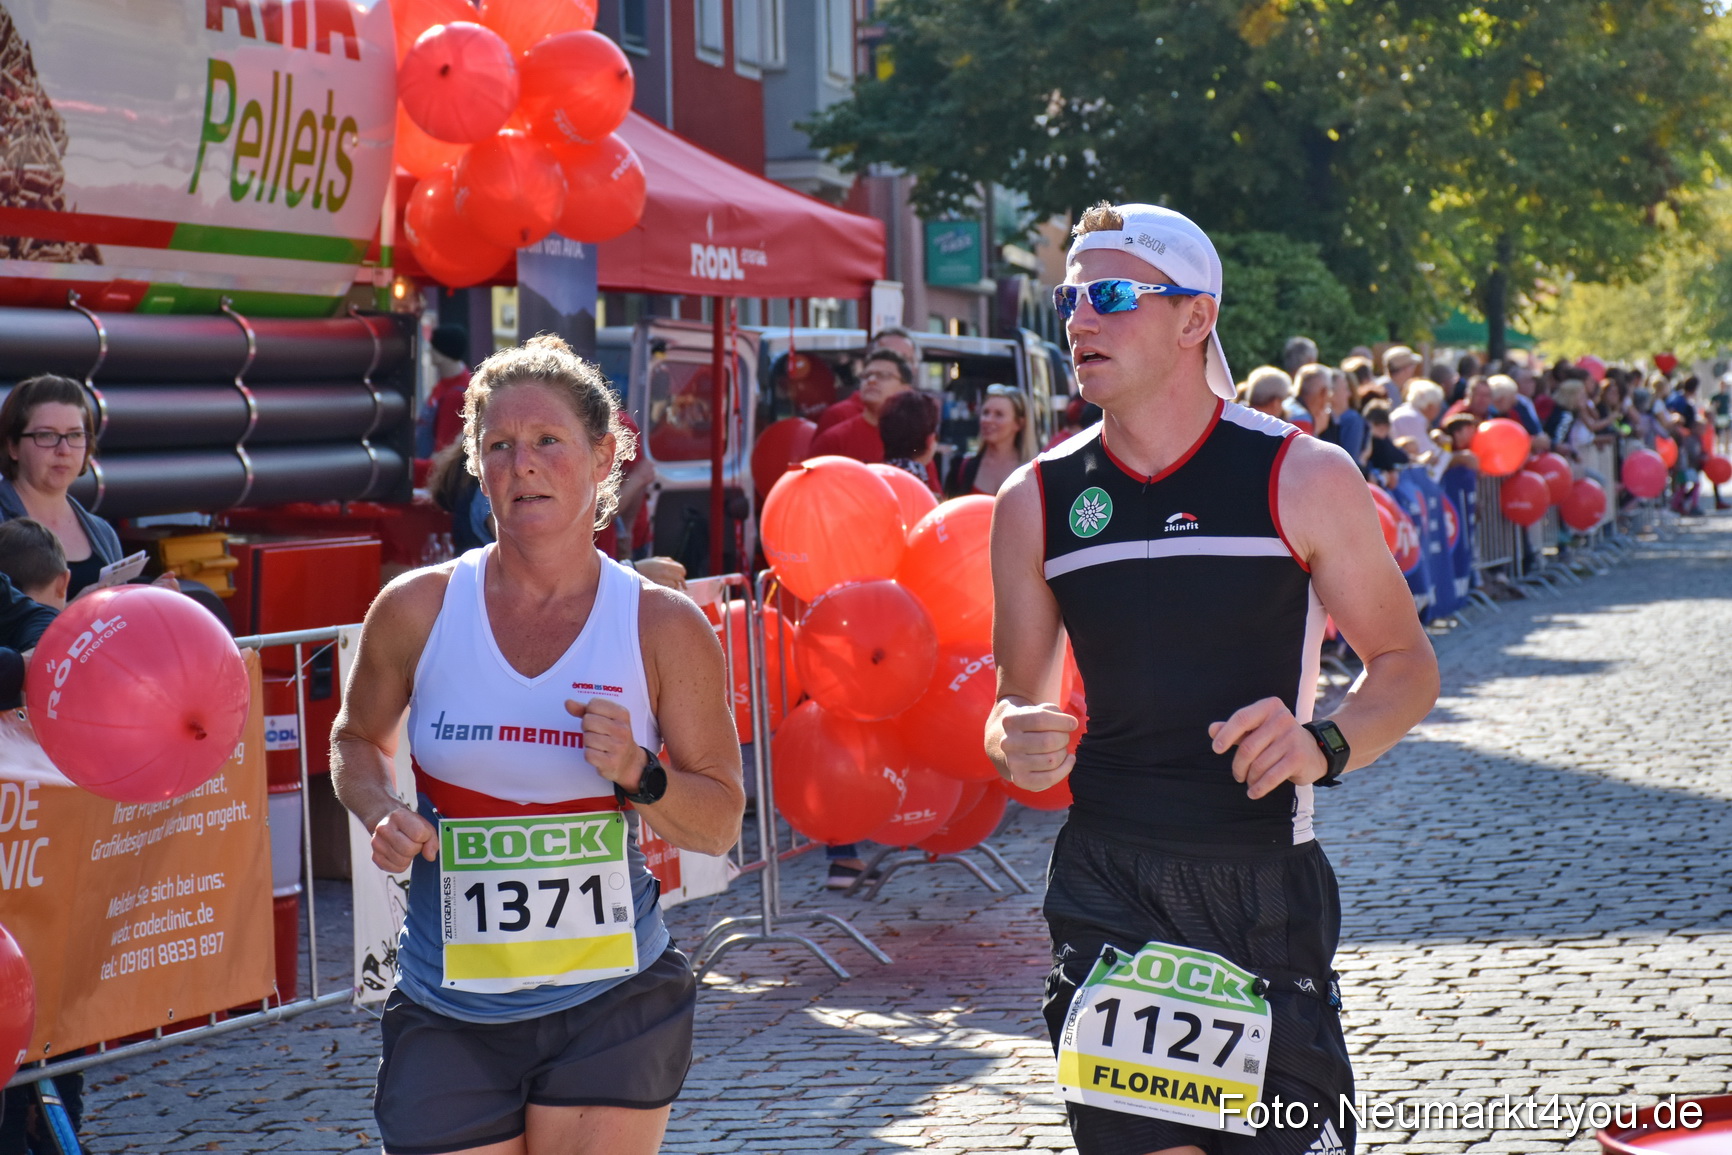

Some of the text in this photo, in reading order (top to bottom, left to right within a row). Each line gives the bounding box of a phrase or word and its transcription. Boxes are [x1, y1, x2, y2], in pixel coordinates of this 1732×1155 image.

[187, 57, 359, 214] Pellets
[1164, 522, 1199, 532] skinfit
[80, 621, 127, 663] energie
[46, 615, 122, 720] RÖDL
[948, 653, 995, 692] RÖD
[430, 711, 584, 749] team memm
[91, 800, 251, 861] Grafikdesign und Werbung angeht.
[112, 801, 137, 825] Ihrer
[455, 822, 606, 862] BOCK
[106, 872, 225, 919] Melden Sie sich bei uns:
[464, 875, 605, 933] 1371
[111, 902, 214, 946] web: codeclinic.de
[100, 931, 224, 980] tel: 09181 8833 897
[1095, 997, 1245, 1068] 1127
[1251, 1028, 1260, 1039] A
[1092, 1065, 1223, 1107] FLORIAN
